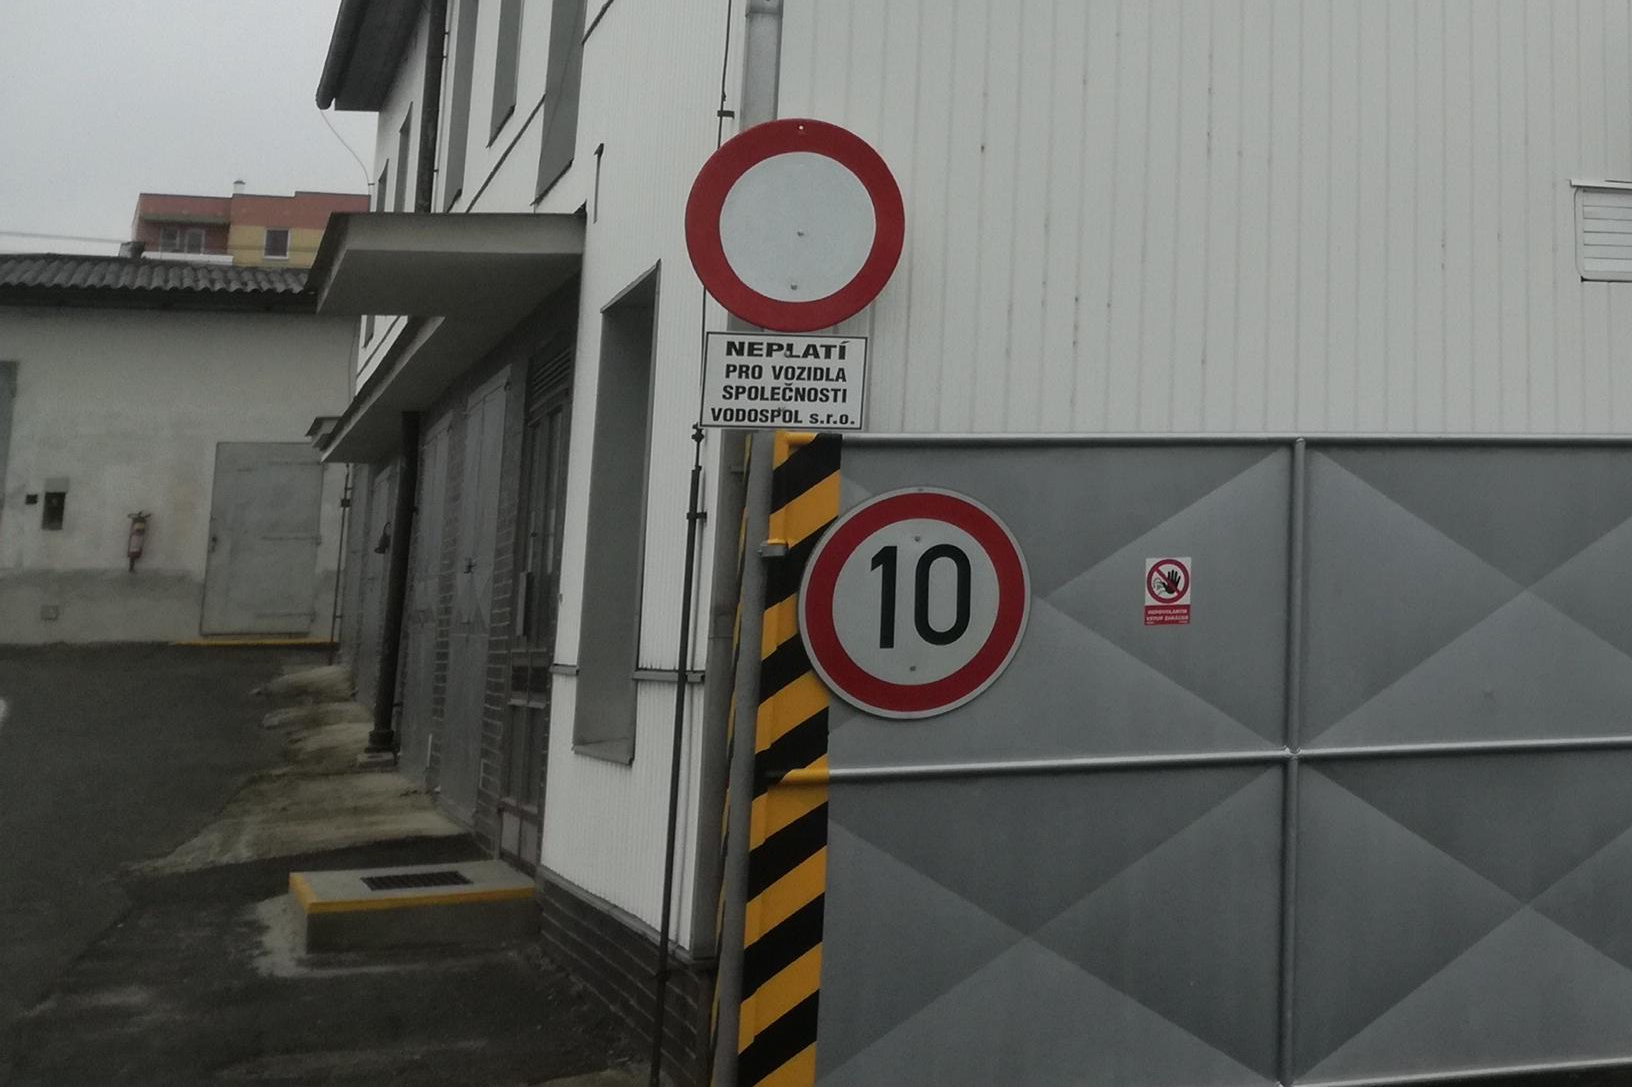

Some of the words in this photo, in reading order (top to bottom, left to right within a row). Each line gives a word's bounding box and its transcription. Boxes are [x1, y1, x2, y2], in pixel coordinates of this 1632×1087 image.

[725, 340, 850, 360] NEPLATÍ
[725, 364, 763, 380] PRO
[771, 365, 847, 382] VOZIDLA
[722, 383, 847, 403] SPOLEČNOSTI
[711, 407, 803, 424] VODOSPOL
[809, 413, 855, 425] s.r.o.
[870, 543, 972, 649] 10
